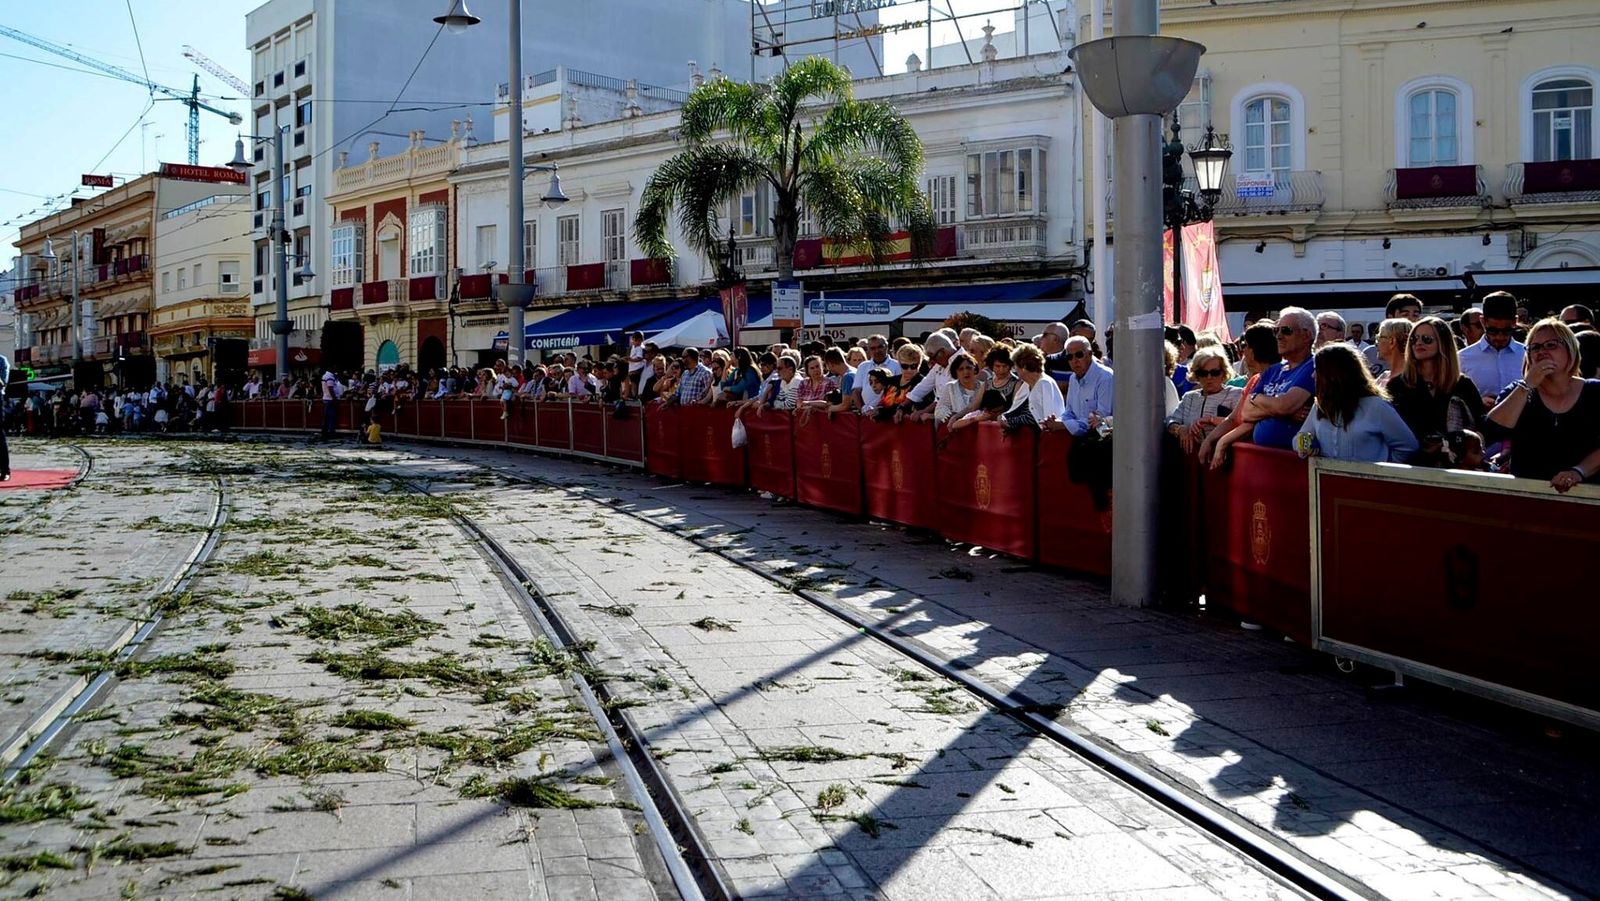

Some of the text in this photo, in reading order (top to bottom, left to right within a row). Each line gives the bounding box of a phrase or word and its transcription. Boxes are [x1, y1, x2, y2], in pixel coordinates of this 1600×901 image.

[180, 167, 240, 180] HOTEL ROMA
[84, 176, 111, 185] ROMA
[531, 334, 580, 349] CONFITERÍA
